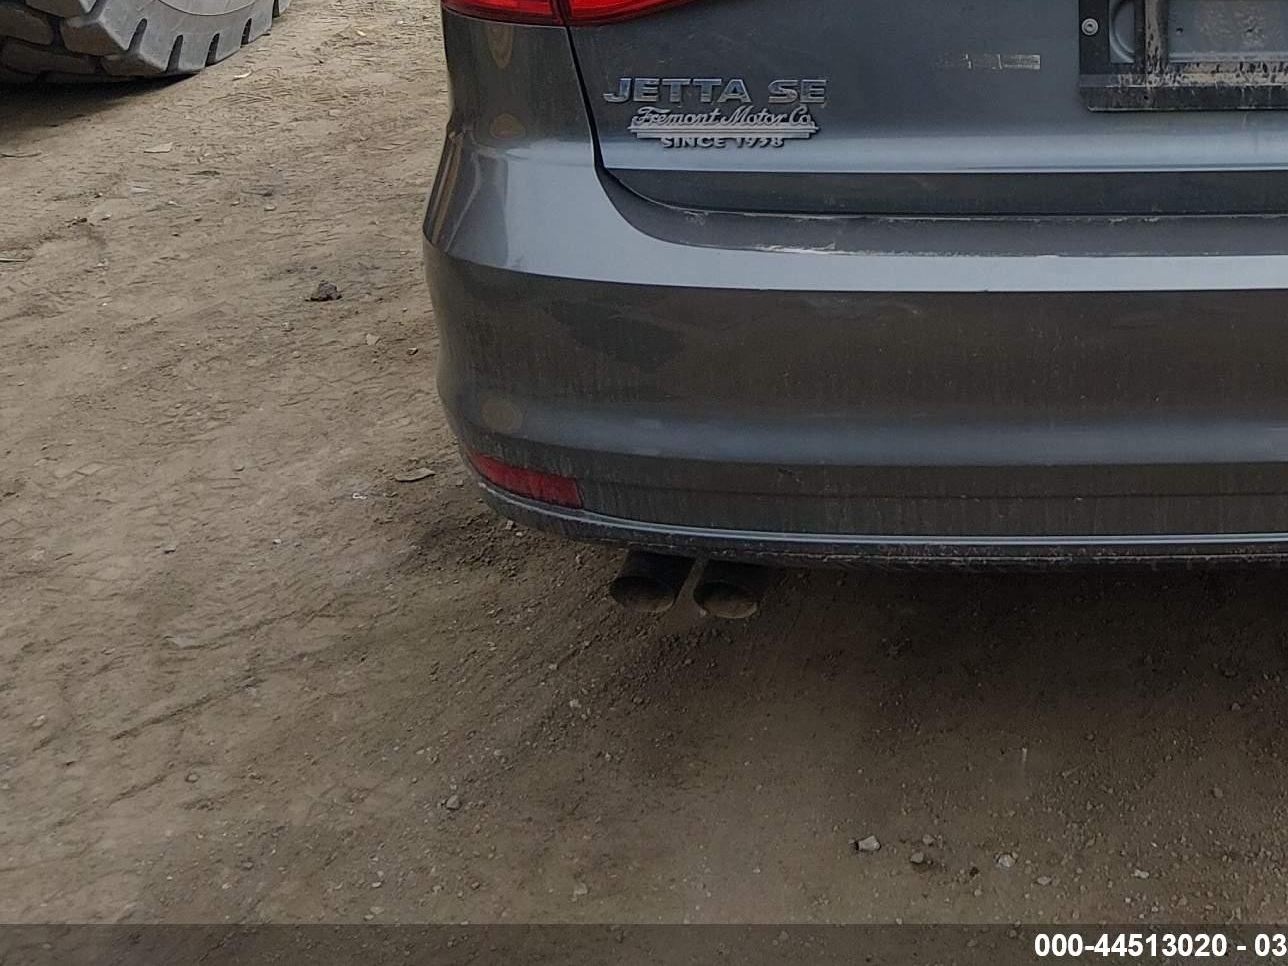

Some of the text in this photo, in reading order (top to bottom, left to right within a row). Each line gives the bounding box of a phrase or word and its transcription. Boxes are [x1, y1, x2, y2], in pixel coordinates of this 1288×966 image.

[603, 77, 827, 104] JETTA SE
[632, 105, 721, 125] Fremont
[720, 104, 788, 126] Motor
[661, 137, 726, 148] SINCE
